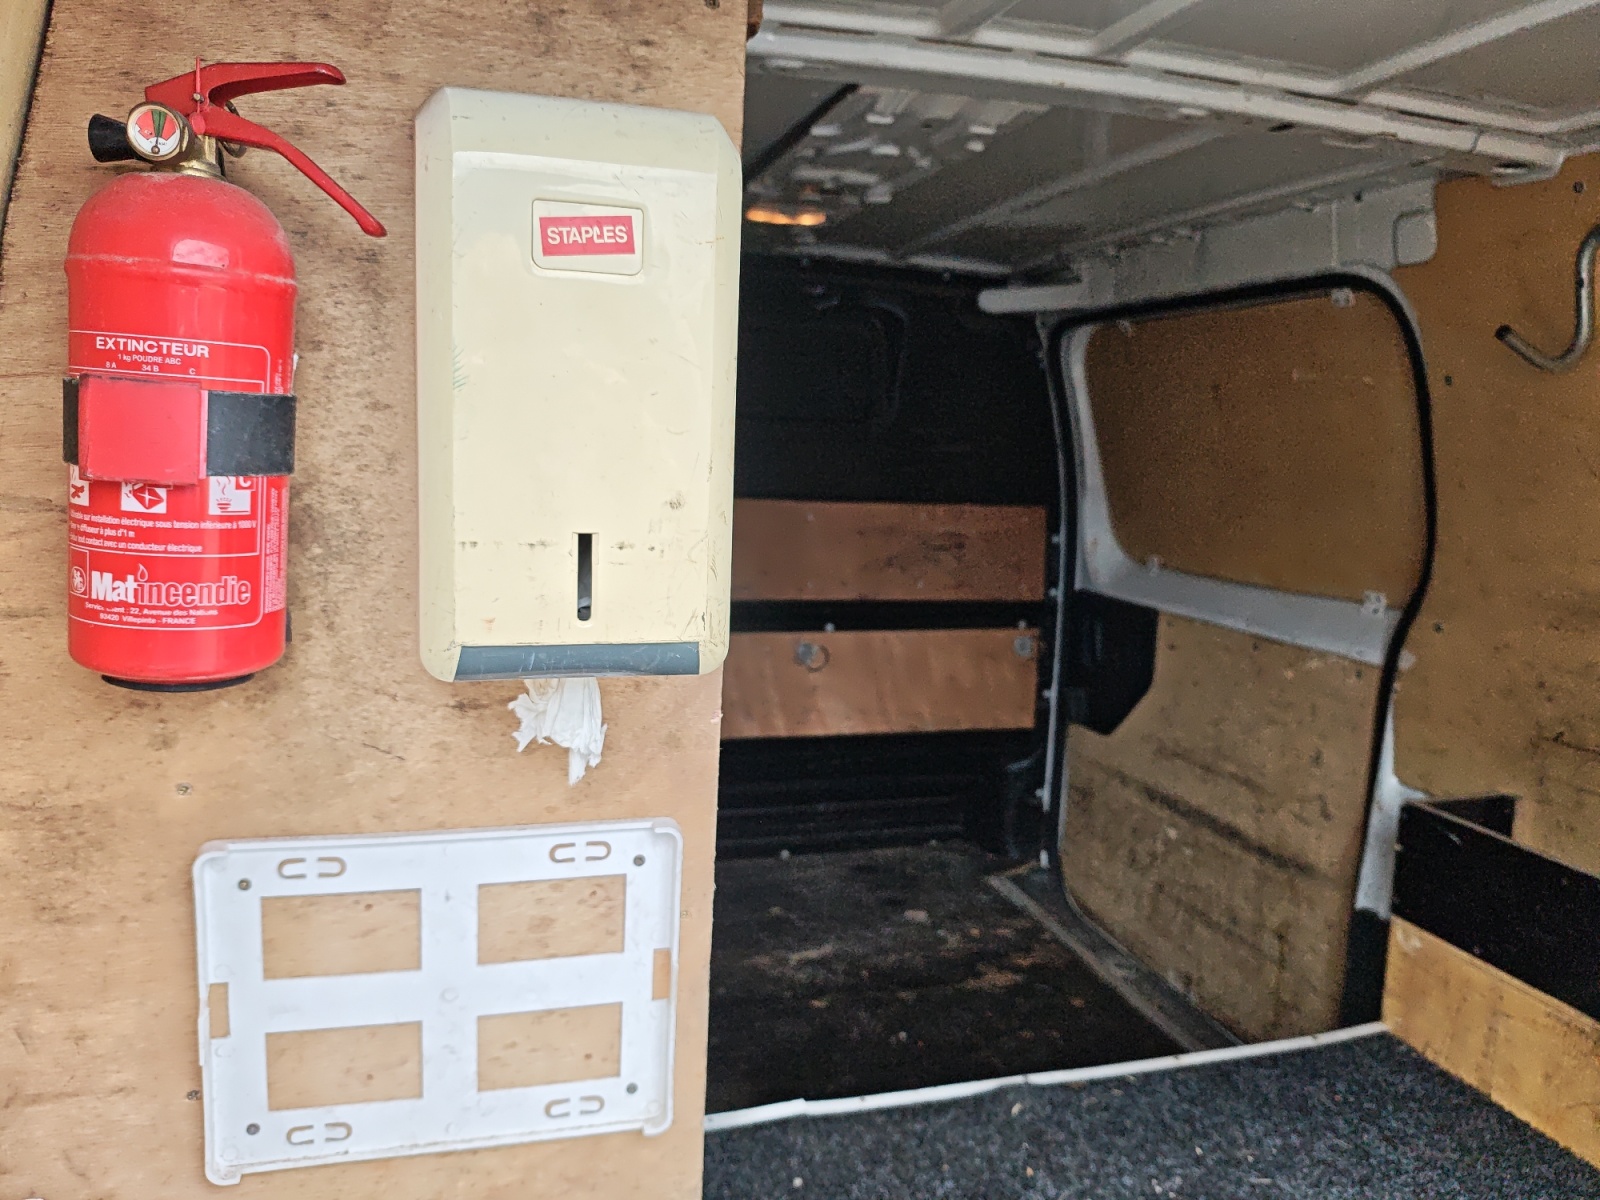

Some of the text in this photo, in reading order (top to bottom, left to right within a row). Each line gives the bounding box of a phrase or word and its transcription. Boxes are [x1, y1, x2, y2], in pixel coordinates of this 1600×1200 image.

[547, 225, 628, 245] STAPLES
[95, 336, 209, 358] EXTINCTEUR
[123, 354, 131, 363] kg
[132, 355, 163, 364] POUDRE
[165, 358, 182, 366] ABC
[142, 364, 150, 372] 34
[189, 368, 196, 376] C
[91, 514, 120, 524] installation
[120, 516, 154, 528] électrique
[155, 520, 173, 528] sous
[173, 520, 200, 529] tension
[200, 520, 232, 530] inférieure
[104, 528, 116, 537] plus
[104, 540, 118, 548] avec
[127, 542, 166, 552] conducteur
[166, 543, 202, 554] électrique
[142, 608, 172, 616] Avenue
[122, 615, 156, 624] Villepinte
[162, 617, 197, 625] FRANCE
